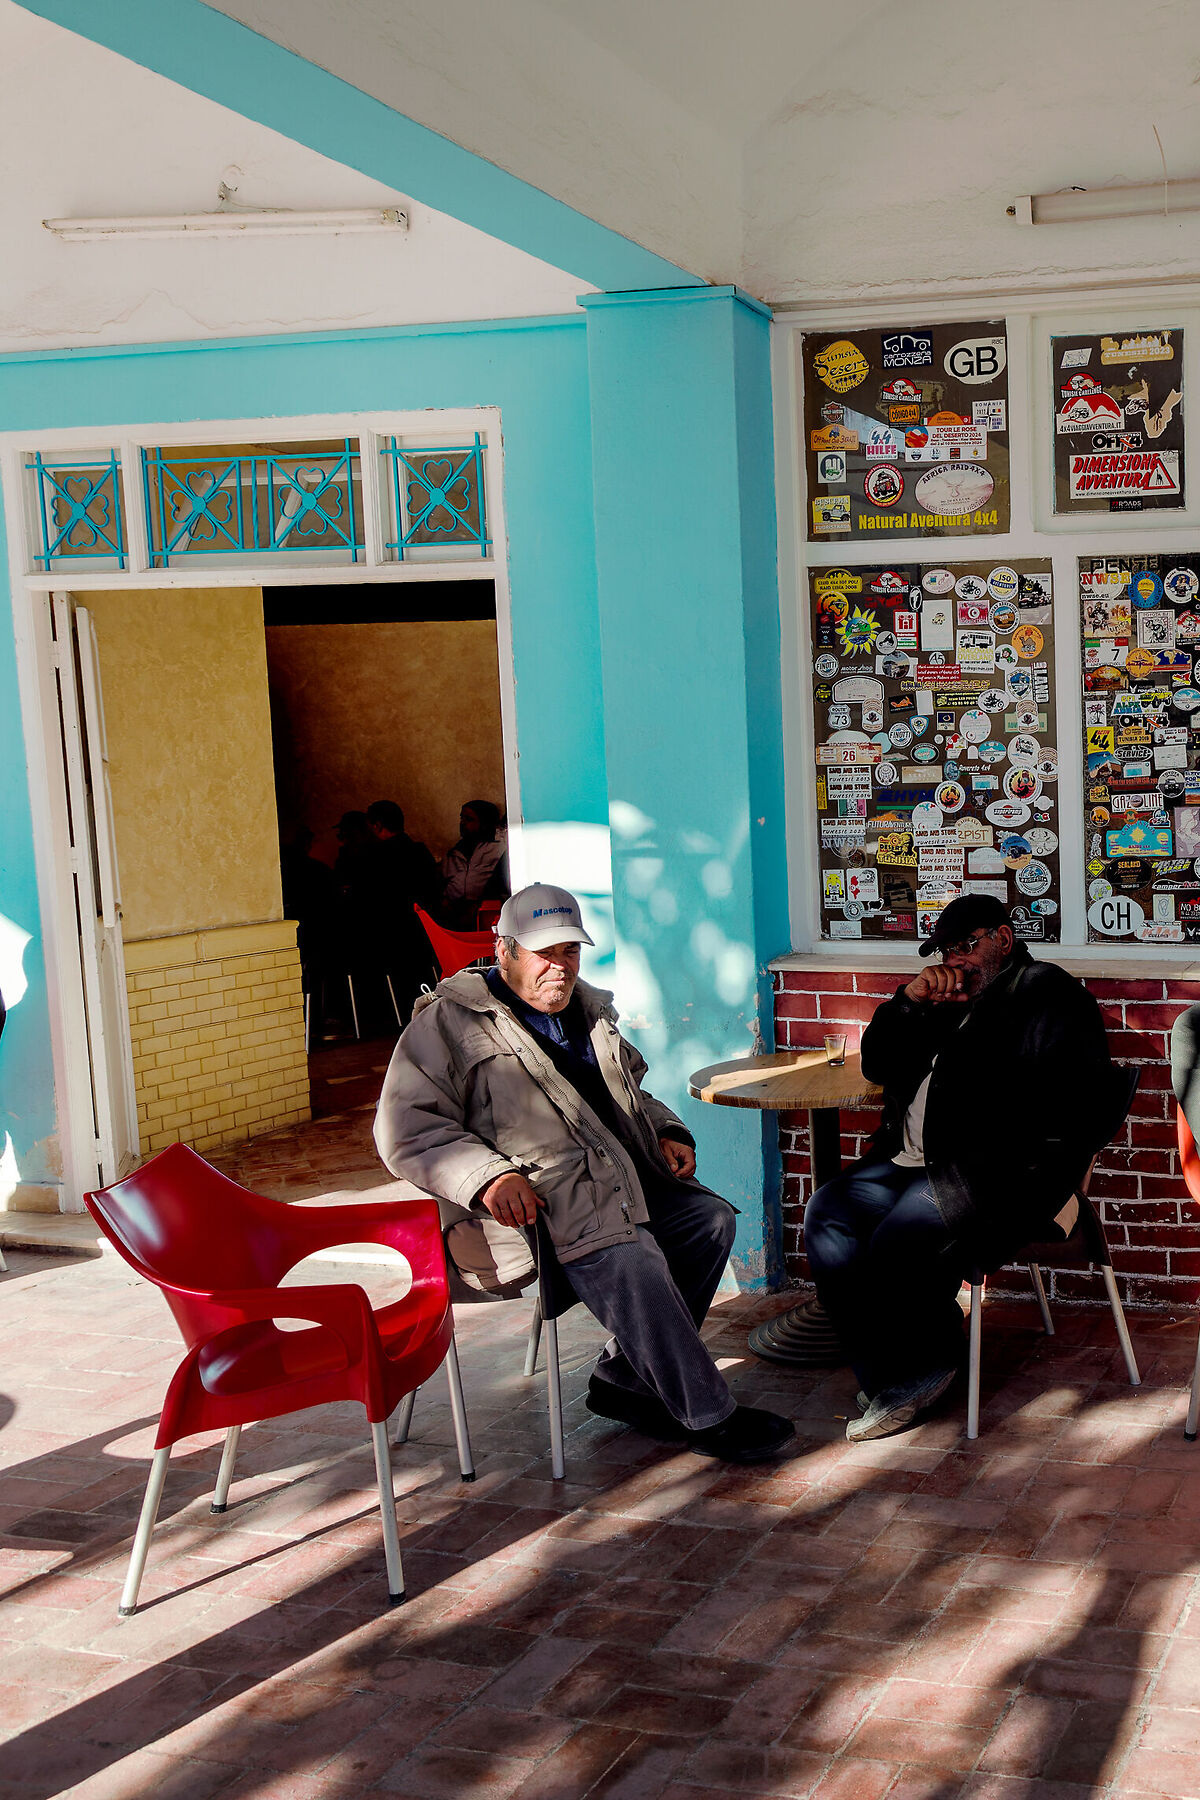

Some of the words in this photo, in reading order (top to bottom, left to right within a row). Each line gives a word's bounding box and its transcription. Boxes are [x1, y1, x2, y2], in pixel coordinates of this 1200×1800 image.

[1149, 346, 1170, 356] 2023
[883, 356, 932, 368] MONZA
[949, 346, 999, 378] GB
[813, 360, 870, 379] Desert
[866, 445, 897, 455] HILFE
[1072, 453, 1160, 474] DIMENSIONE
[922, 466, 949, 484] AFRICA
[950, 464, 969, 472] RAID
[1075, 471, 1151, 490] AVVENTURA
[858, 513, 908, 530] Natural
[910, 512, 971, 528] Aventura
[974, 510, 998, 526] 4x4
[1080, 572, 1131, 585] NWSE
[1111, 648, 1120, 661] 7
[834, 715, 848, 725] 73
[843, 750, 856, 762] 26
[1117, 750, 1148, 758] SERVICE
[1180, 904, 1192, 912] NO
[1101, 901, 1131, 930] CH
